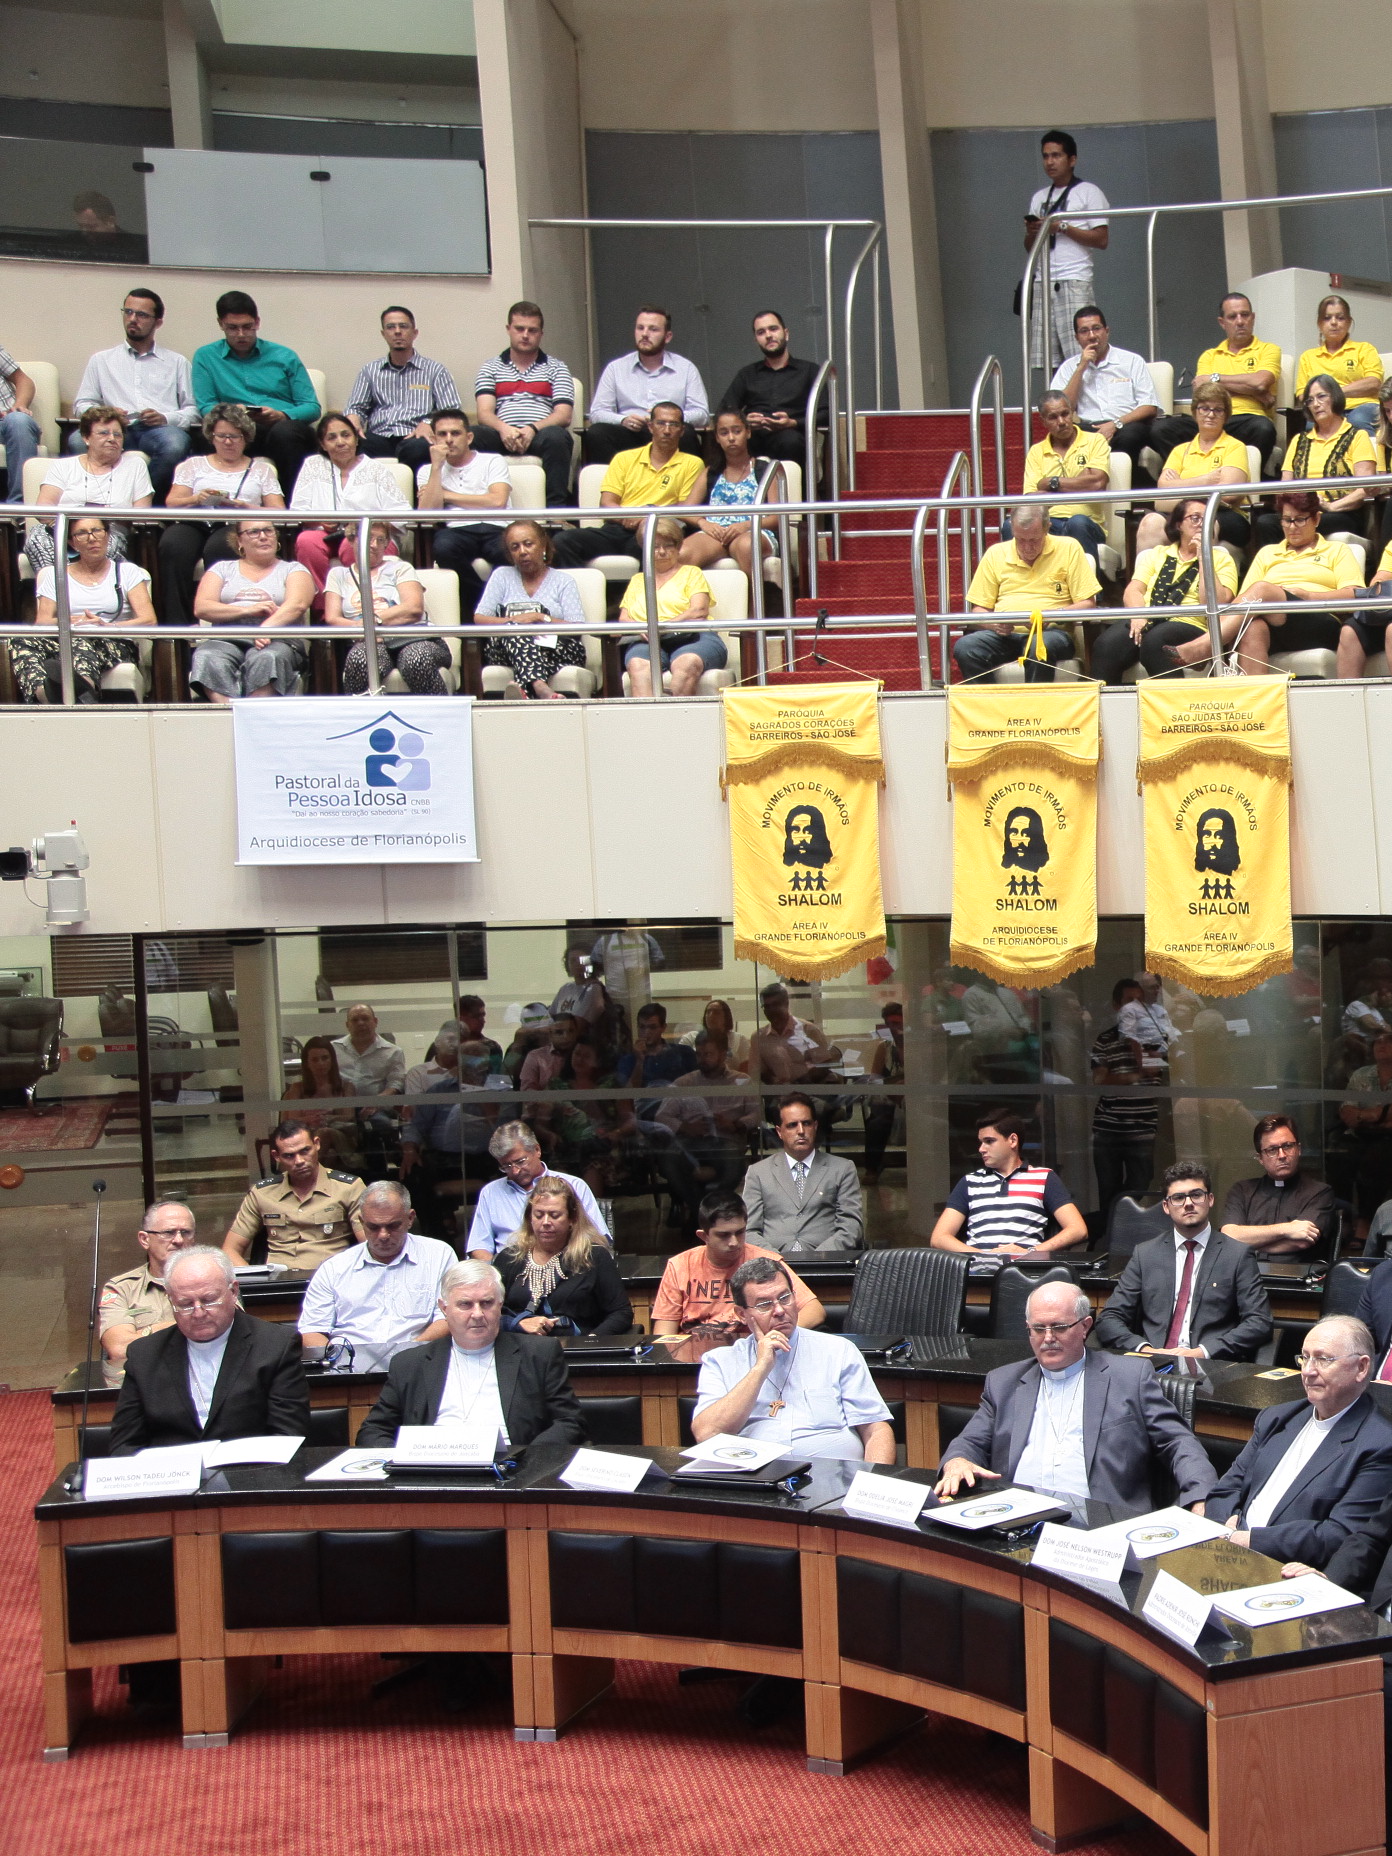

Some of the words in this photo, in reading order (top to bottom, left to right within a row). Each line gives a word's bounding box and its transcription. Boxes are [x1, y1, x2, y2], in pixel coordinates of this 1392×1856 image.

[1188, 701, 1235, 711] PARÓQUIA
[777, 709, 825, 718] PARÓQUIA
[1193, 711, 1222, 722] JUDAS
[1224, 711, 1254, 721] TADEU
[749, 719, 801, 730] SAGRADOS
[803, 718, 856, 730] CORAÇÕES
[1006, 717, 1031, 727] ÁREA
[1033, 718, 1042, 727] IV
[1161, 723, 1213, 734] BARREIROS
[1220, 722, 1240, 733] SÃO
[1241, 720, 1266, 732] JOSÉ
[749, 731, 803, 741] BARREIROS
[810, 729, 830, 740] SÃO
[832, 728, 857, 739] JOSÉ
[968, 729, 1006, 739] GRANDE
[1008, 725, 1081, 738] FLORIANÓPOLIS
[275, 774, 342, 789] Pastoral
[344, 776, 361, 789] da
[288, 791, 351, 807] Pessoa
[353, 789, 407, 807] Idosa
[410, 798, 431, 806] CNBB
[762, 781, 805, 829] MOVIMENTO
[808, 781, 823, 793] DE
[823, 786, 850, 827] IRMÃOS
[984, 782, 1026, 828] MOVIMENTO
[1028, 782, 1043, 795] DE
[1043, 788, 1067, 831] IRMÃOS
[1175, 783, 1217, 832] MOVIMENTO
[1220, 784, 1234, 796] DE
[1235, 789, 1258, 832] IRMÃOS
[249, 834, 346, 851] Arquidiocese
[350, 833, 369, 847] de
[373, 832, 467, 847] Florianópolis
[778, 892, 842, 907] SHALOM
[995, 898, 1058, 912] SHALOM
[1188, 901, 1250, 915] SHALOM
[792, 920, 817, 931] ÁREA
[819, 921, 829, 930] IV
[992, 926, 1058, 936] ARQUIDIOCESE
[754, 932, 792, 942] GRANDE
[793, 930, 867, 942] FLORIANÓPOLIS
[983, 937, 997, 947] DE
[998, 935, 1068, 947] FLORIANÓPOLIS
[1203, 930, 1228, 941] ÁREA
[1229, 931, 1238, 941] IV
[1164, 942, 1203, 953] GRANDE
[1205, 940, 1275, 953] FLORIANÓPOLIS
[114, 1474, 141, 1482] WILSON
[143, 1472, 166, 1480] TADEU
[1042, 1536, 1055, 1545] DOM
[1070, 1543, 1092, 1554] NELSON
